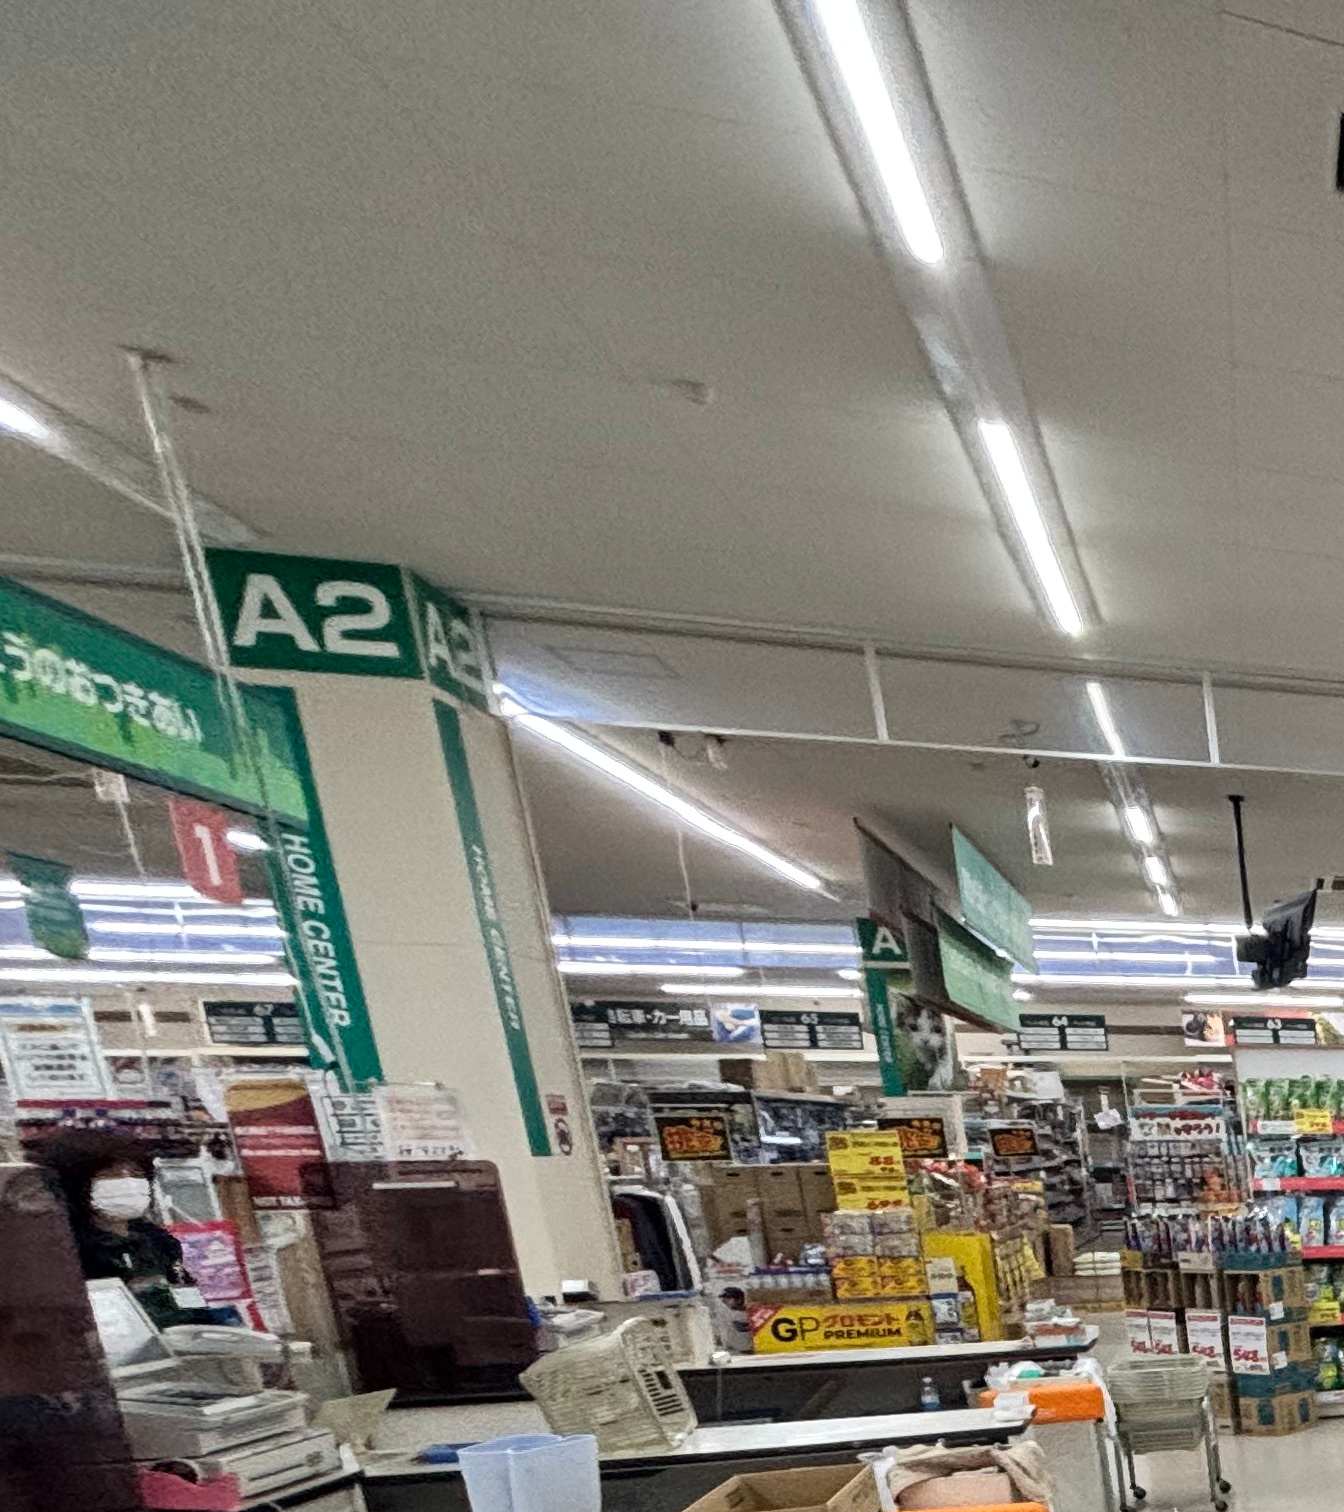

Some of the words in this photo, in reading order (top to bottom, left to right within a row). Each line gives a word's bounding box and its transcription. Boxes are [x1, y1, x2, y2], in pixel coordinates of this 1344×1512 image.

[233, 573, 400, 659] A2
[281, 832, 326, 915] HOME
[301, 919, 351, 1029] CENTER
[771, 1316, 820, 1343] GP
[823, 1327, 903, 1340] PREMIUM
